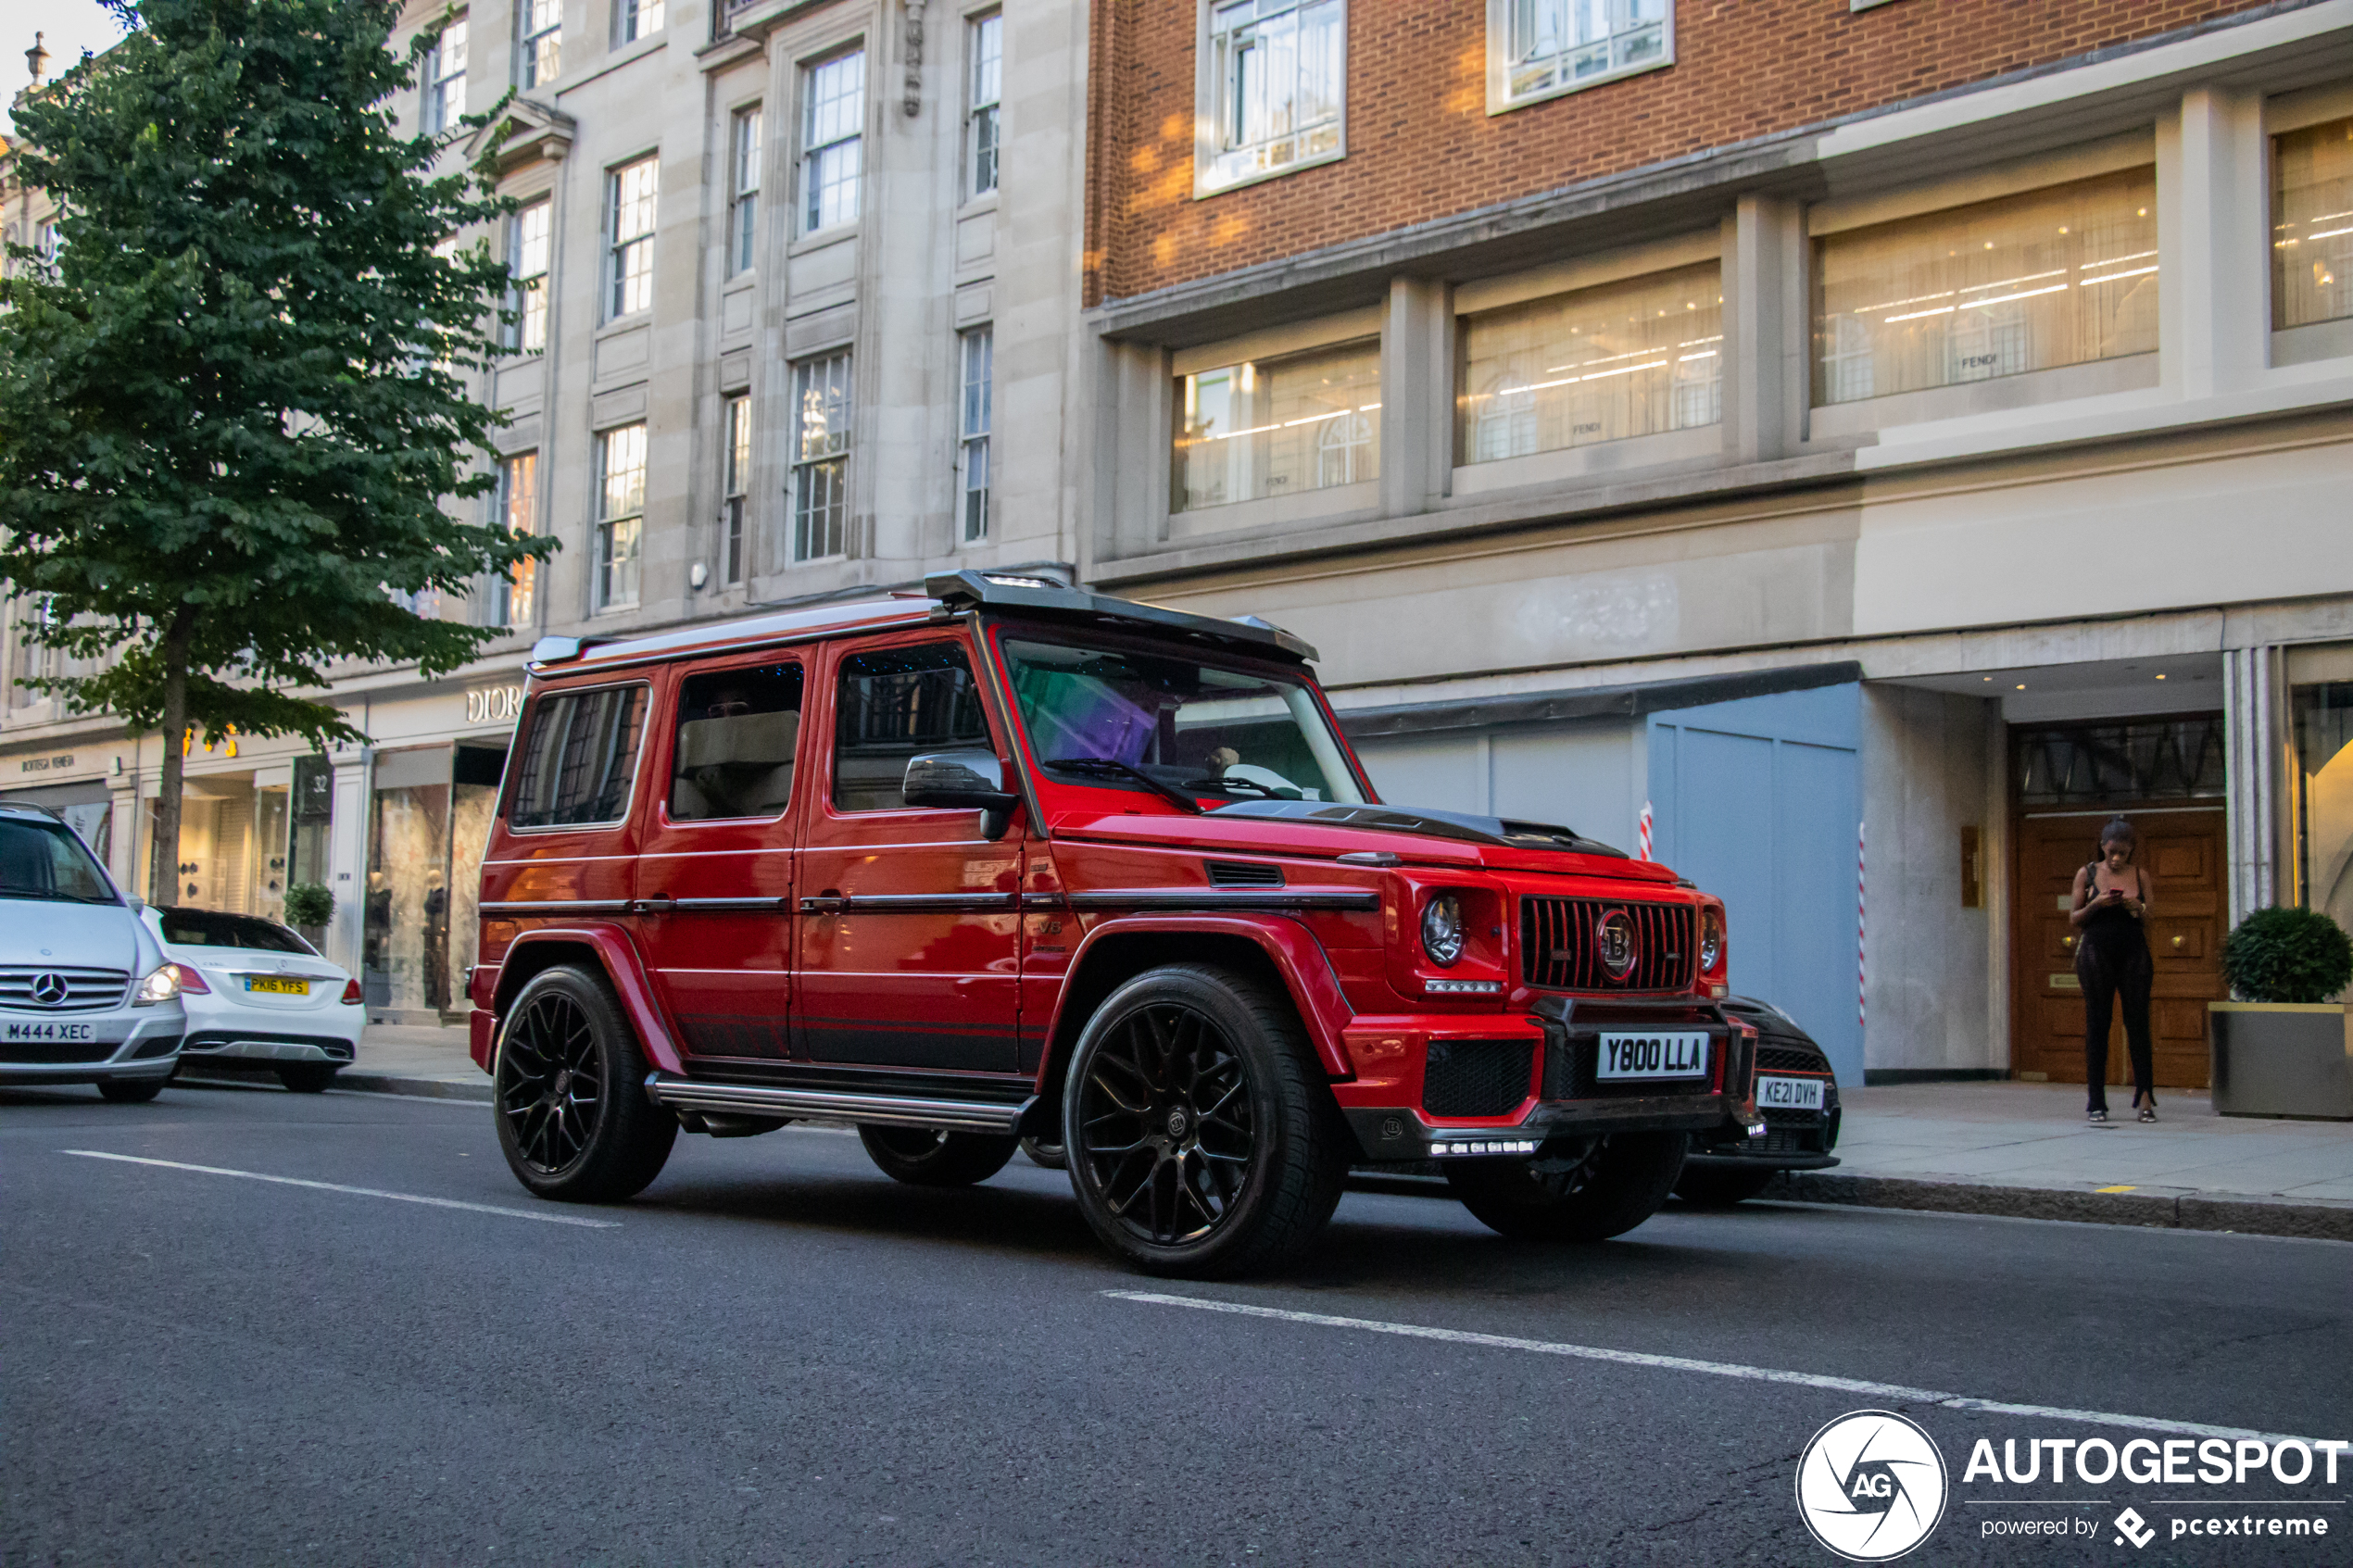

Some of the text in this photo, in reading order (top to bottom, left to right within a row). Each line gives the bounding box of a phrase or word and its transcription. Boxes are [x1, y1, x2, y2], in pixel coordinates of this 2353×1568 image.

[1962, 354, 1996, 370] FENDI
[1573, 422, 1601, 434] FENDI
[466, 686, 521, 722] DIOR
[1038, 922, 1063, 935] V8
[251, 978, 304, 993] PK16 YFS
[8, 1023, 91, 1039] M444 XEC
[1607, 1038, 1701, 1072] Y800 LLA
[1765, 1081, 1818, 1105] KE21 DVH
